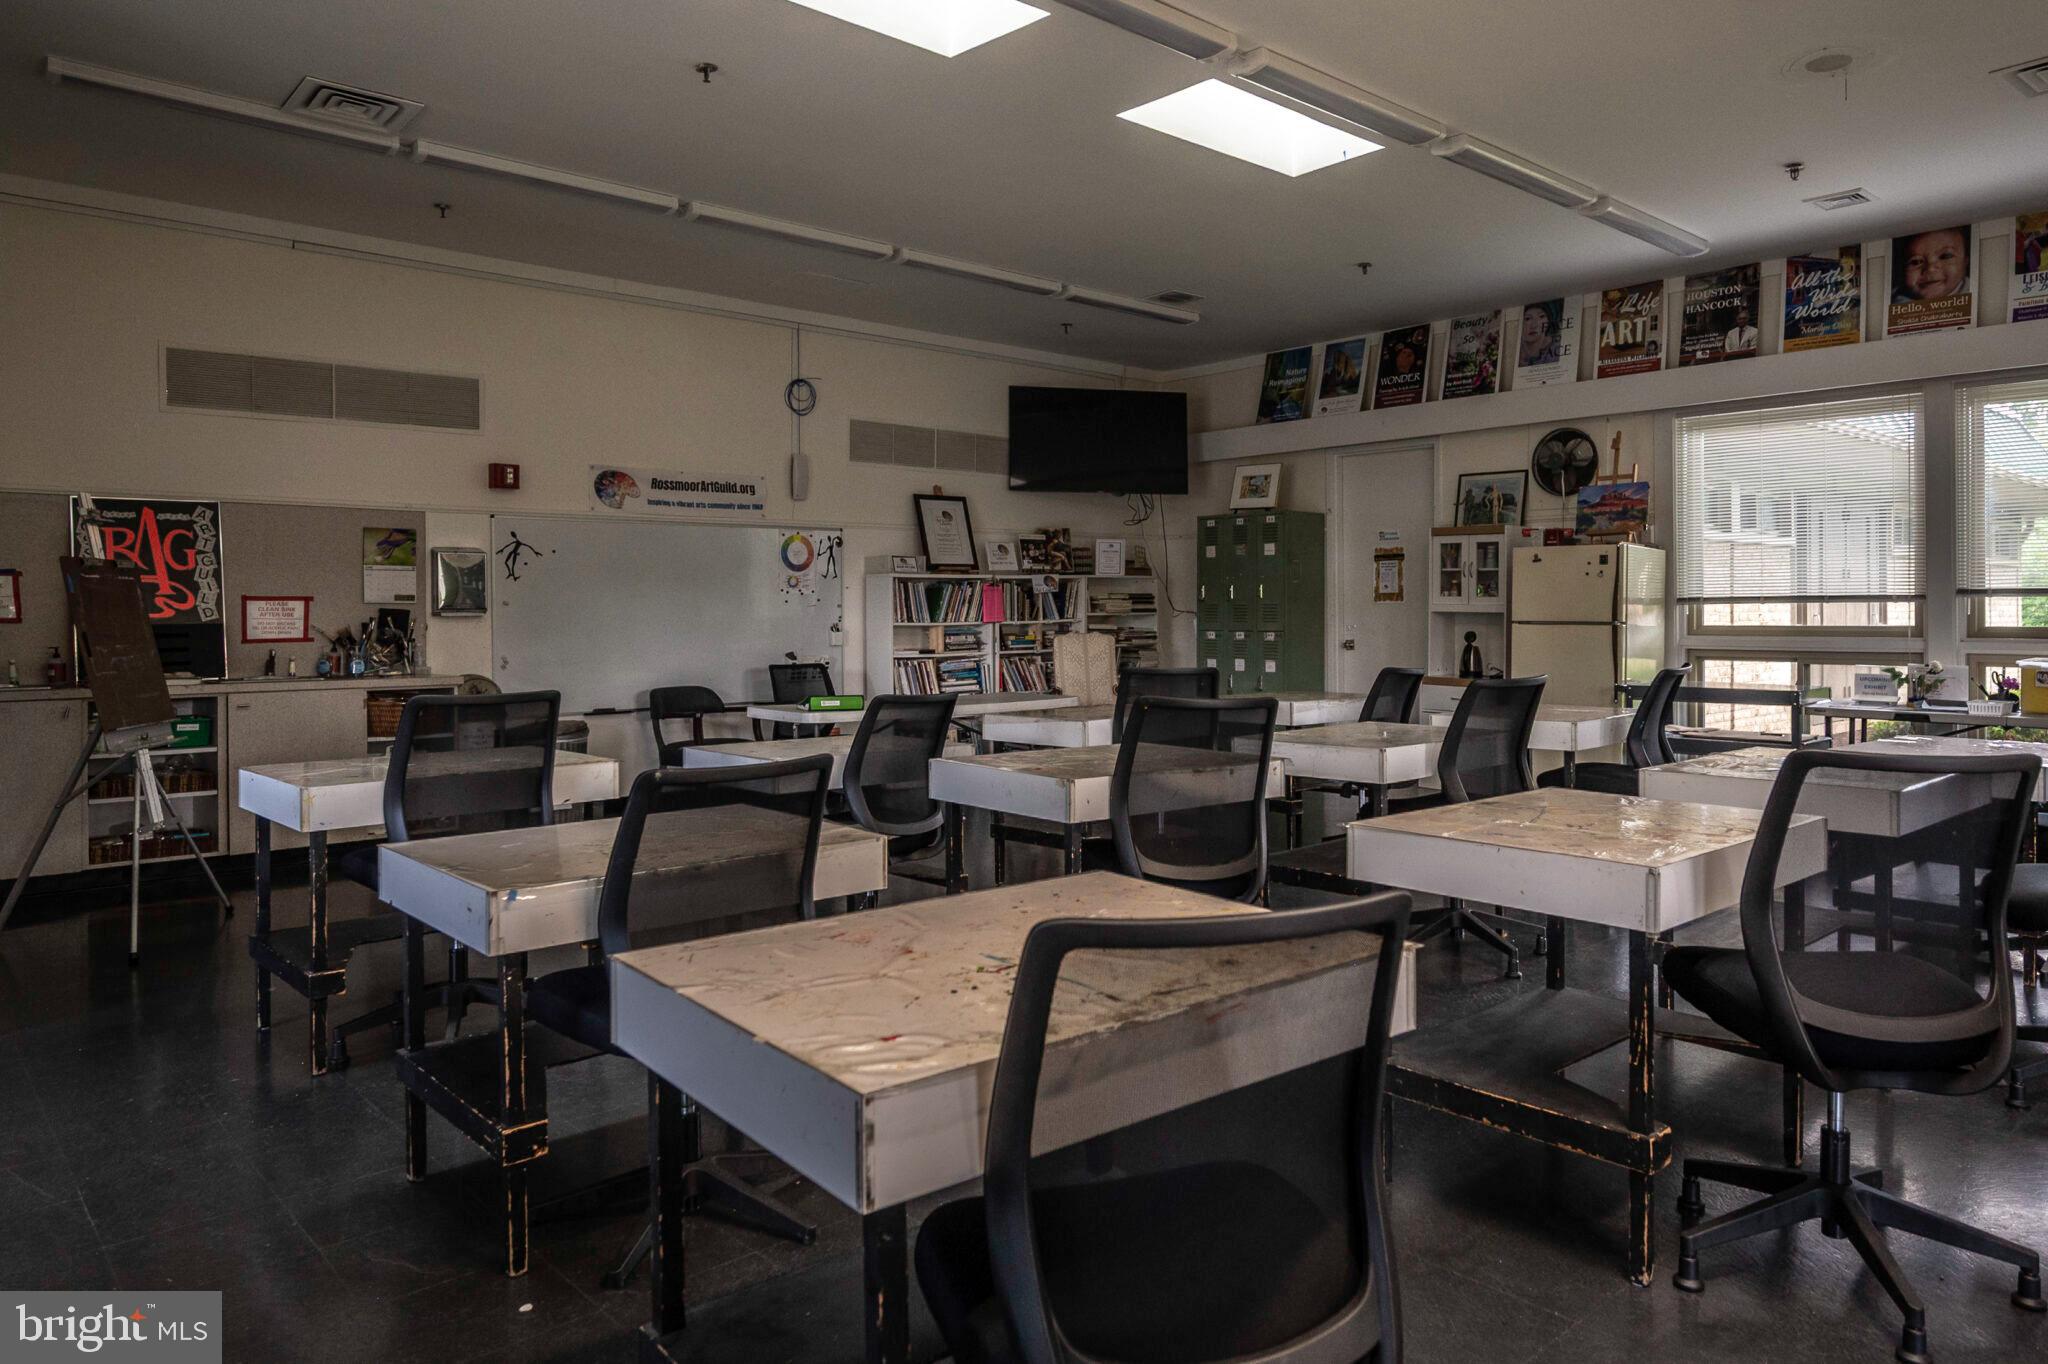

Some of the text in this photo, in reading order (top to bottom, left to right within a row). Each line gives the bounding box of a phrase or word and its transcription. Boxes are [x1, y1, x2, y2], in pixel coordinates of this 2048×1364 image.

[1791, 270, 1822, 290] All
[1687, 284, 1742, 301] HOUSTON
[1616, 291, 1660, 315] Life
[1686, 297, 1741, 314] HANCOCK
[1791, 296, 1851, 319] World
[1892, 296, 1969, 316] Hello, world!
[1453, 317, 1488, 330] Beauty
[1541, 316, 1574, 334] FACE
[1601, 317, 1648, 347] ART
[1462, 335, 1475, 345] So
[1538, 344, 1572, 361] FACE
[1285, 367, 1308, 377] Nature
[1380, 372, 1421, 386] WONDER
[650, 477, 756, 496] RossmoorArtGuild.org
